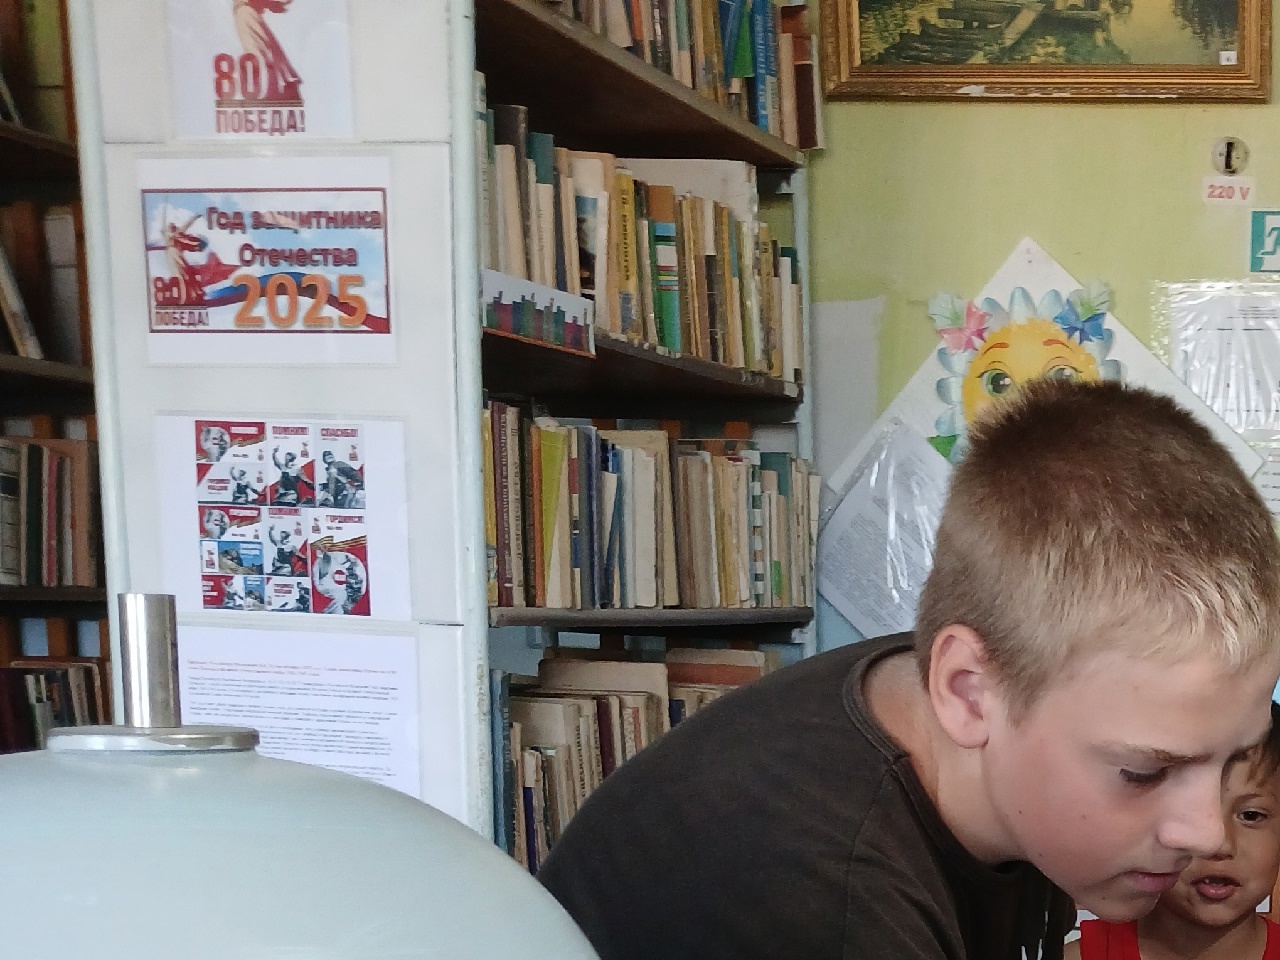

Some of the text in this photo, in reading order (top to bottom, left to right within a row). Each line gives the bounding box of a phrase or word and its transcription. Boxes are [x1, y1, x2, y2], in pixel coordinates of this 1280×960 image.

[214, 52, 260, 100] 80
[215, 109, 305, 136] ПОБЕДА!
[1207, 184, 1250, 200] 220 V
[206, 206, 383, 234] Год зщитника
[238, 243, 359, 267] Отечества
[232, 273, 367, 328] 2025
[154, 311, 209, 328] ПОБЕДА!
